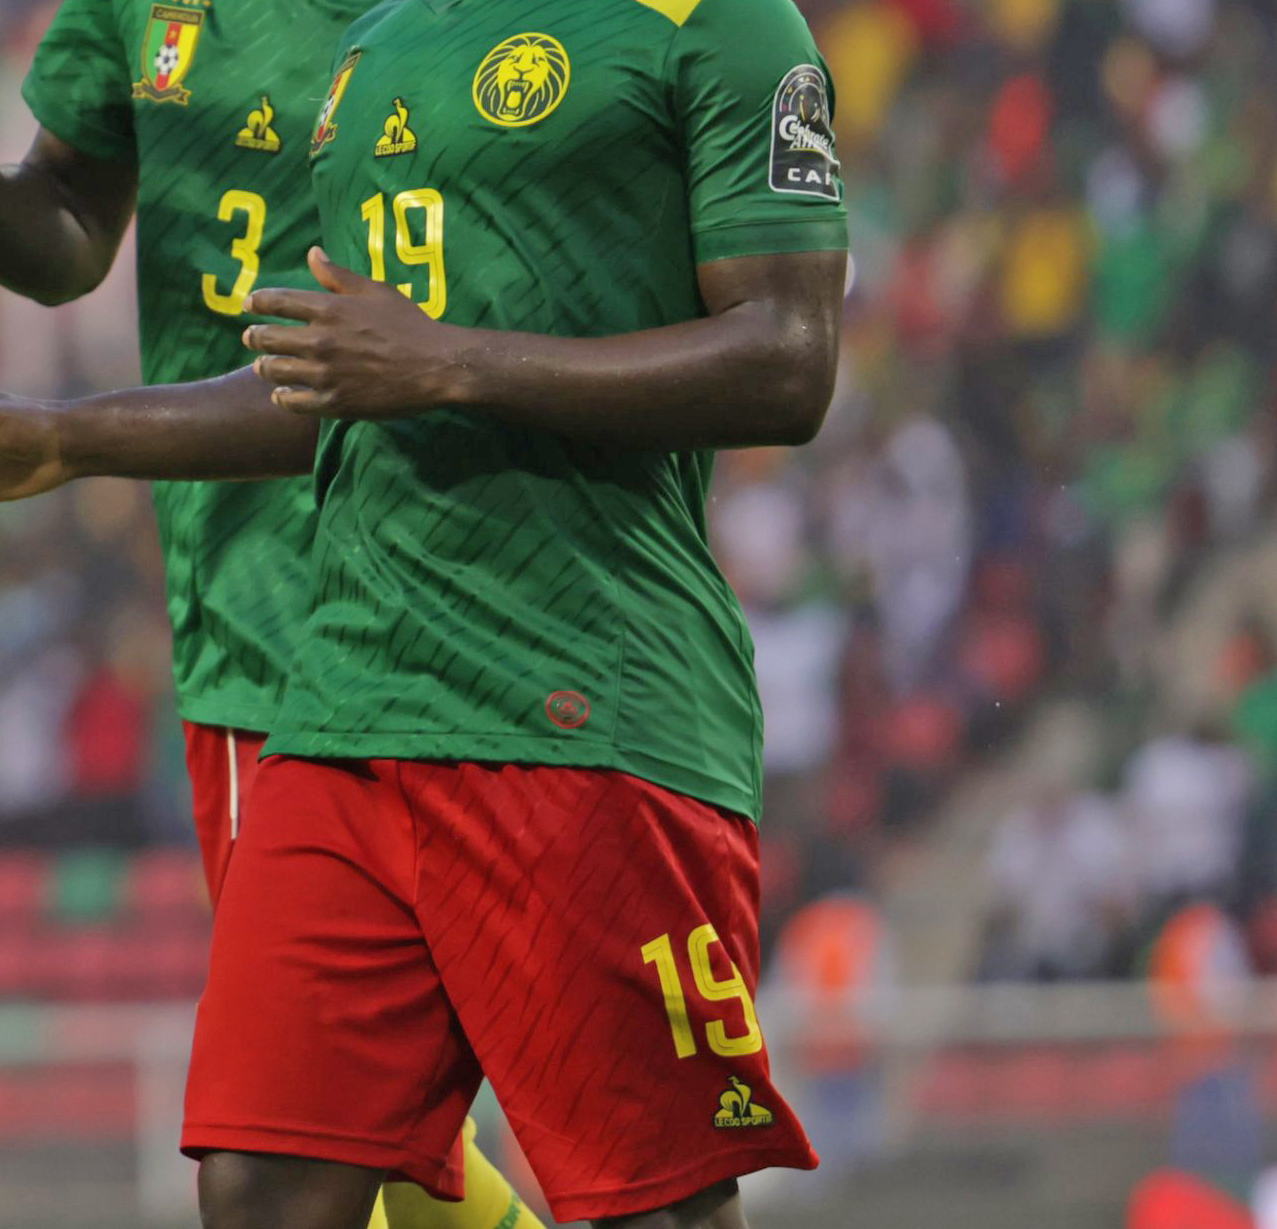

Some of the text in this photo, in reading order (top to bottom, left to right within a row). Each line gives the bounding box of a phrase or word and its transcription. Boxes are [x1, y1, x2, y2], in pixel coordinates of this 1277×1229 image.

[202, 190, 266, 315] 3
[361, 188, 446, 319] 19
[641, 923, 762, 1059] 19
